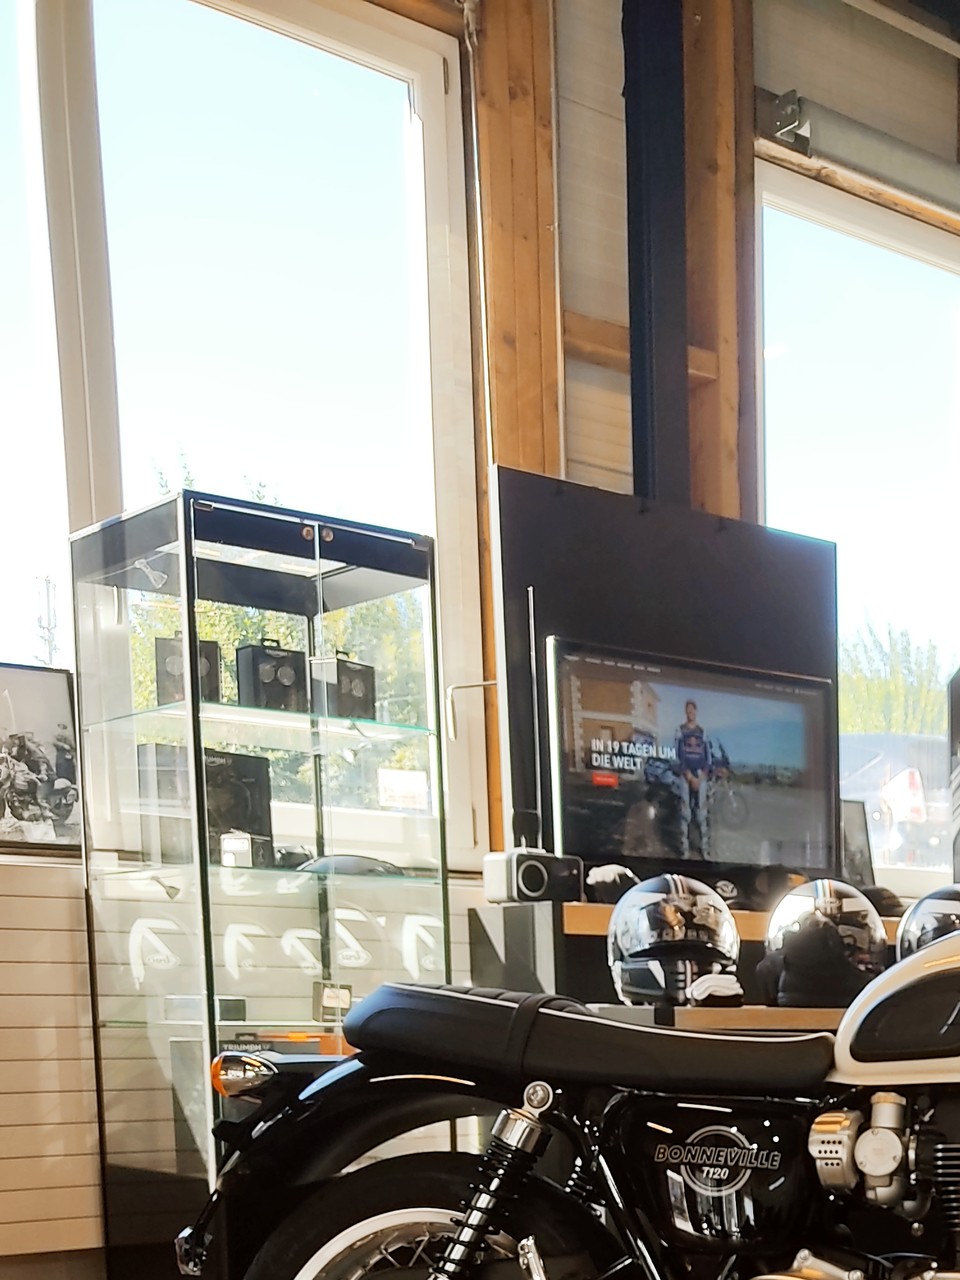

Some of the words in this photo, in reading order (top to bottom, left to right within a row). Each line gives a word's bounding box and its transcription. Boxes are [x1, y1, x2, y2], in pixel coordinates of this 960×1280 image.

[591, 738, 604, 752] IN
[607, 741, 620, 753] 19
[621, 741, 657, 757] TAGEN
[658, 746, 677, 760] UM
[592, 753, 611, 767] DIE
[612, 755, 643, 770] WELT
[654, 1144, 781, 1170] BONNEVILLE
[701, 1166, 729, 1180] T120
